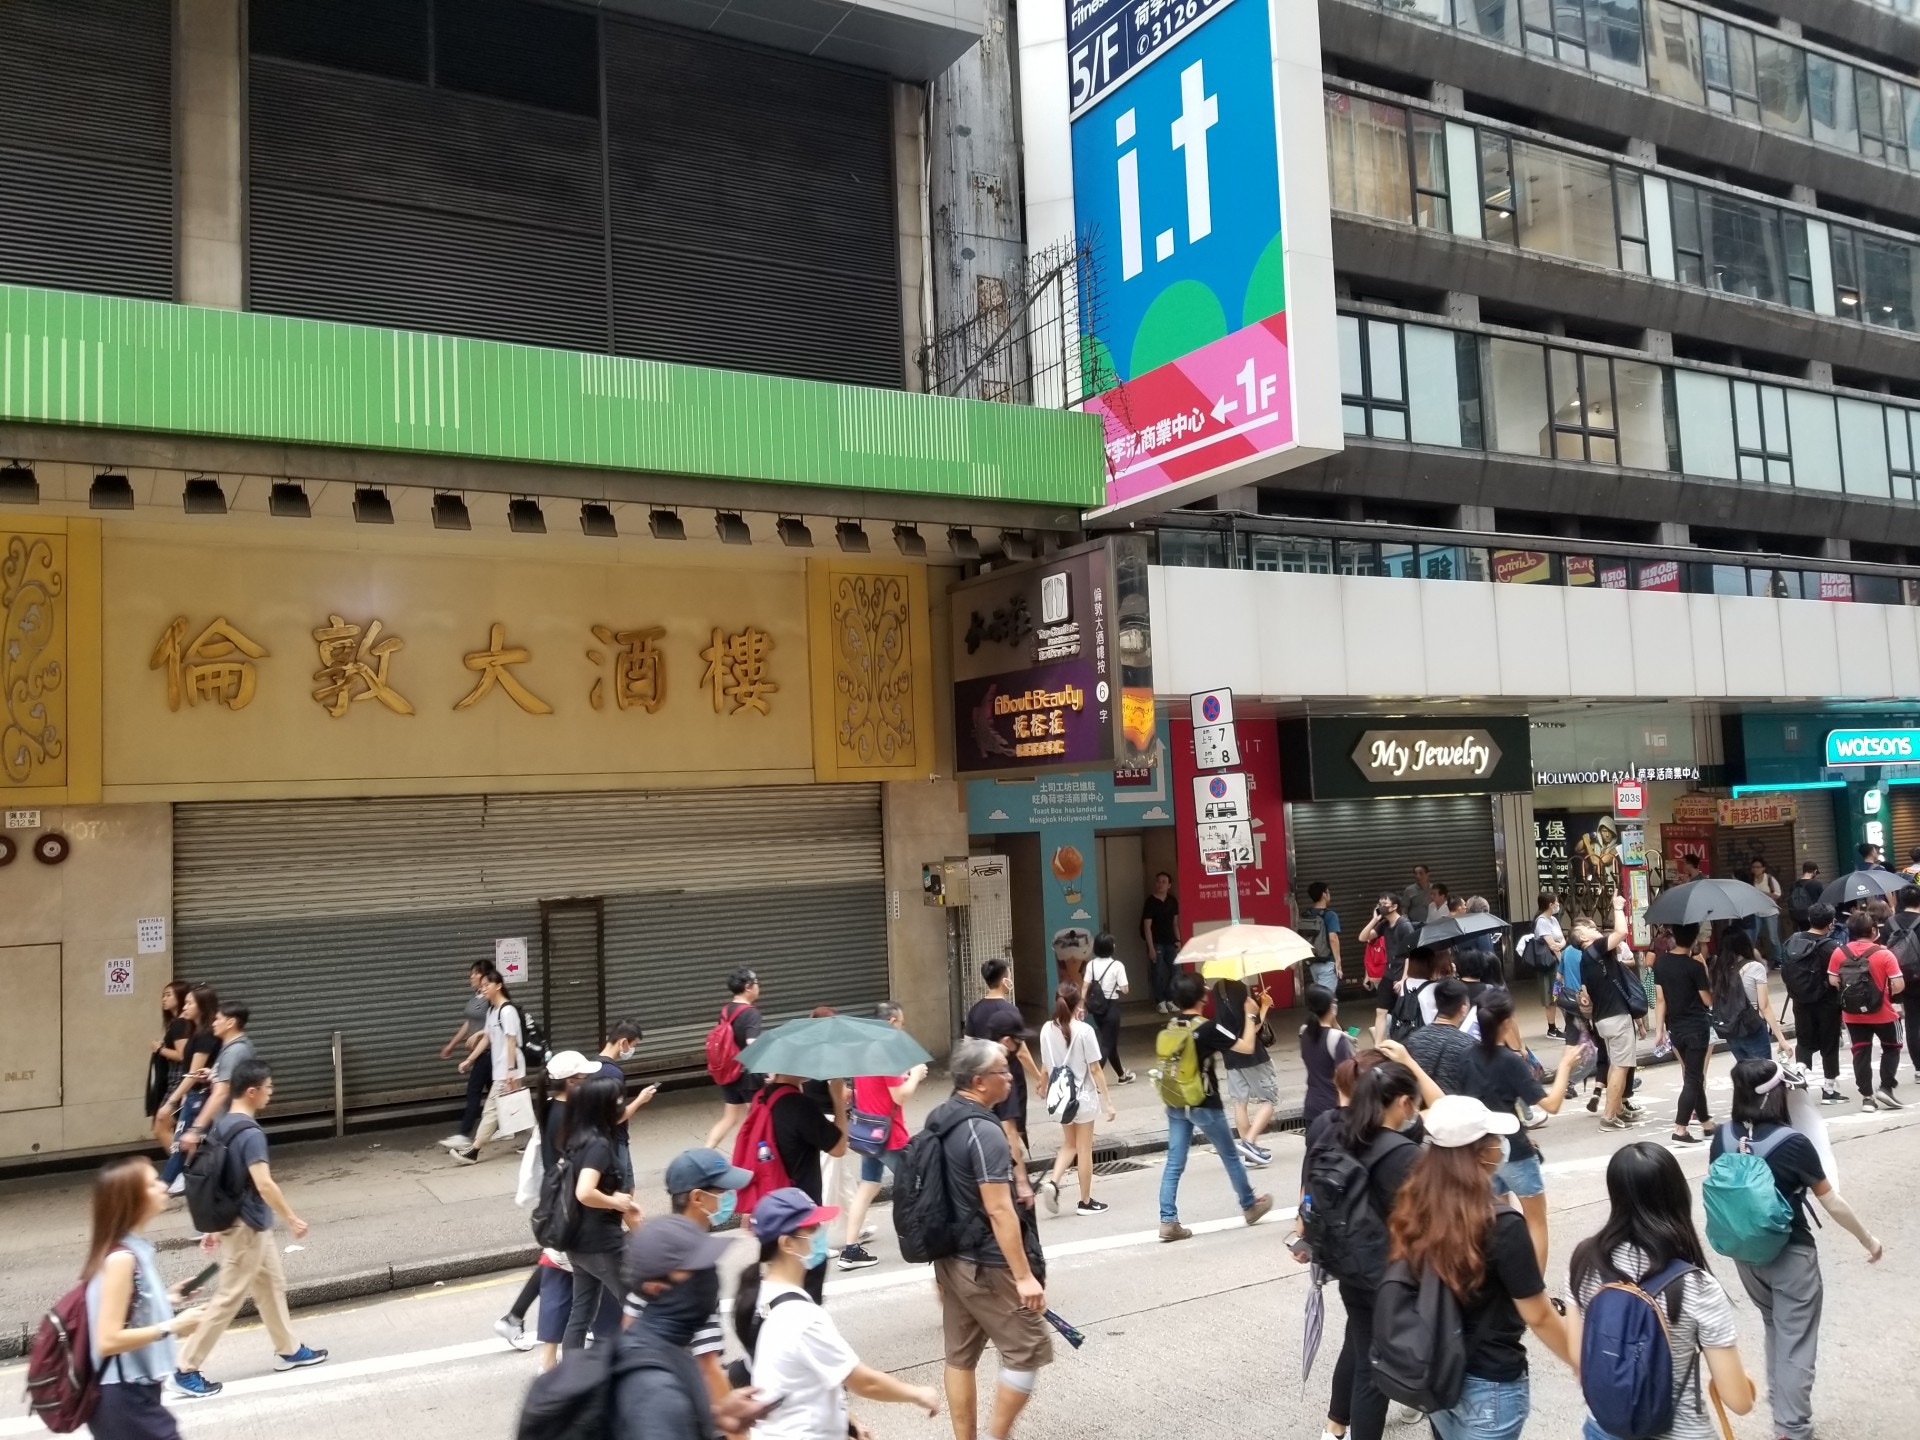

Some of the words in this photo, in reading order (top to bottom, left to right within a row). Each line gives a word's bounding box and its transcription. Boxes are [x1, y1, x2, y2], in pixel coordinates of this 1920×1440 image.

[1071, 0, 1108, 31] Fitnes
[1152, 0, 1198, 46] 3126
[1072, 22, 1119, 108] 5/F
[1115, 58, 1219, 282] i.t
[150, 615, 778, 717] 倫敦大酒樓
[1099, 709, 1108, 723] 字
[1218, 728, 1225, 741] 7
[1835, 736, 1913, 757] watsons
[1222, 750, 1230, 763] 8
[1371, 740, 1409, 776] My
[1412, 736, 1490, 775] Jewelry
[1637, 766, 1700, 783] 荷李活商業中心
[1039, 781, 1096, 793] 土司工坊已進駐
[1032, 792, 1104, 805] 旺角荷李活商業中心
[1033, 807, 1050, 815] Toast
[1064, 806, 1075, 814] has
[1076, 805, 1097, 813] landed
[1730, 805, 1778, 823] 荷李活15樓
[1029, 815, 1057, 825] Mongkok
[1058, 814, 1090, 824] Hollywood
[1091, 813, 1108, 821] Plaza
[1228, 825, 1237, 839] 7
[1231, 847, 1250, 861] 12
[1535, 846, 1568, 858] ICAL
[1674, 843, 1706, 860] SIM
[4, 1070, 36, 1082] INLET
